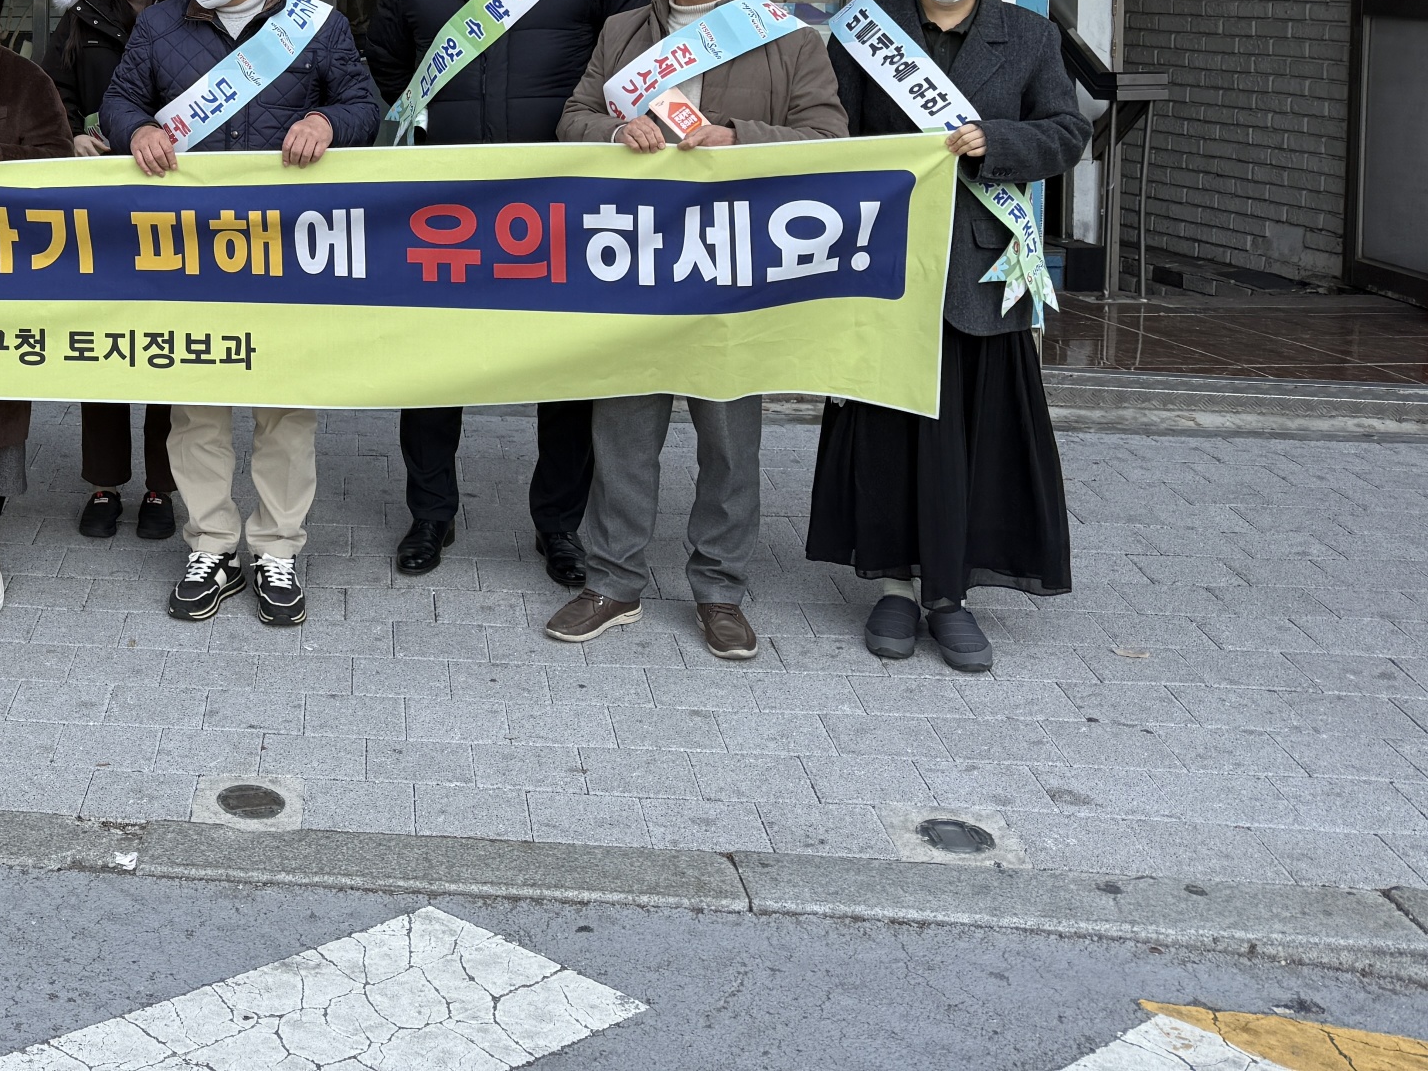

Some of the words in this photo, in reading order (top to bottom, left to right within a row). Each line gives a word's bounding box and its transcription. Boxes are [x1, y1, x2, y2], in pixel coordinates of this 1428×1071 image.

[464, 17, 485, 40] 수
[622, 43, 699, 107] 전세사기
[845, 8, 920, 83] 바른세상을
[908, 76, 952, 117] 위한
[188, 76, 240, 123] 다가구
[130, 206, 367, 281] 피해에
[406, 199, 881, 288] 유의하세요!
[64, 329, 257, 370] 토지정보과
